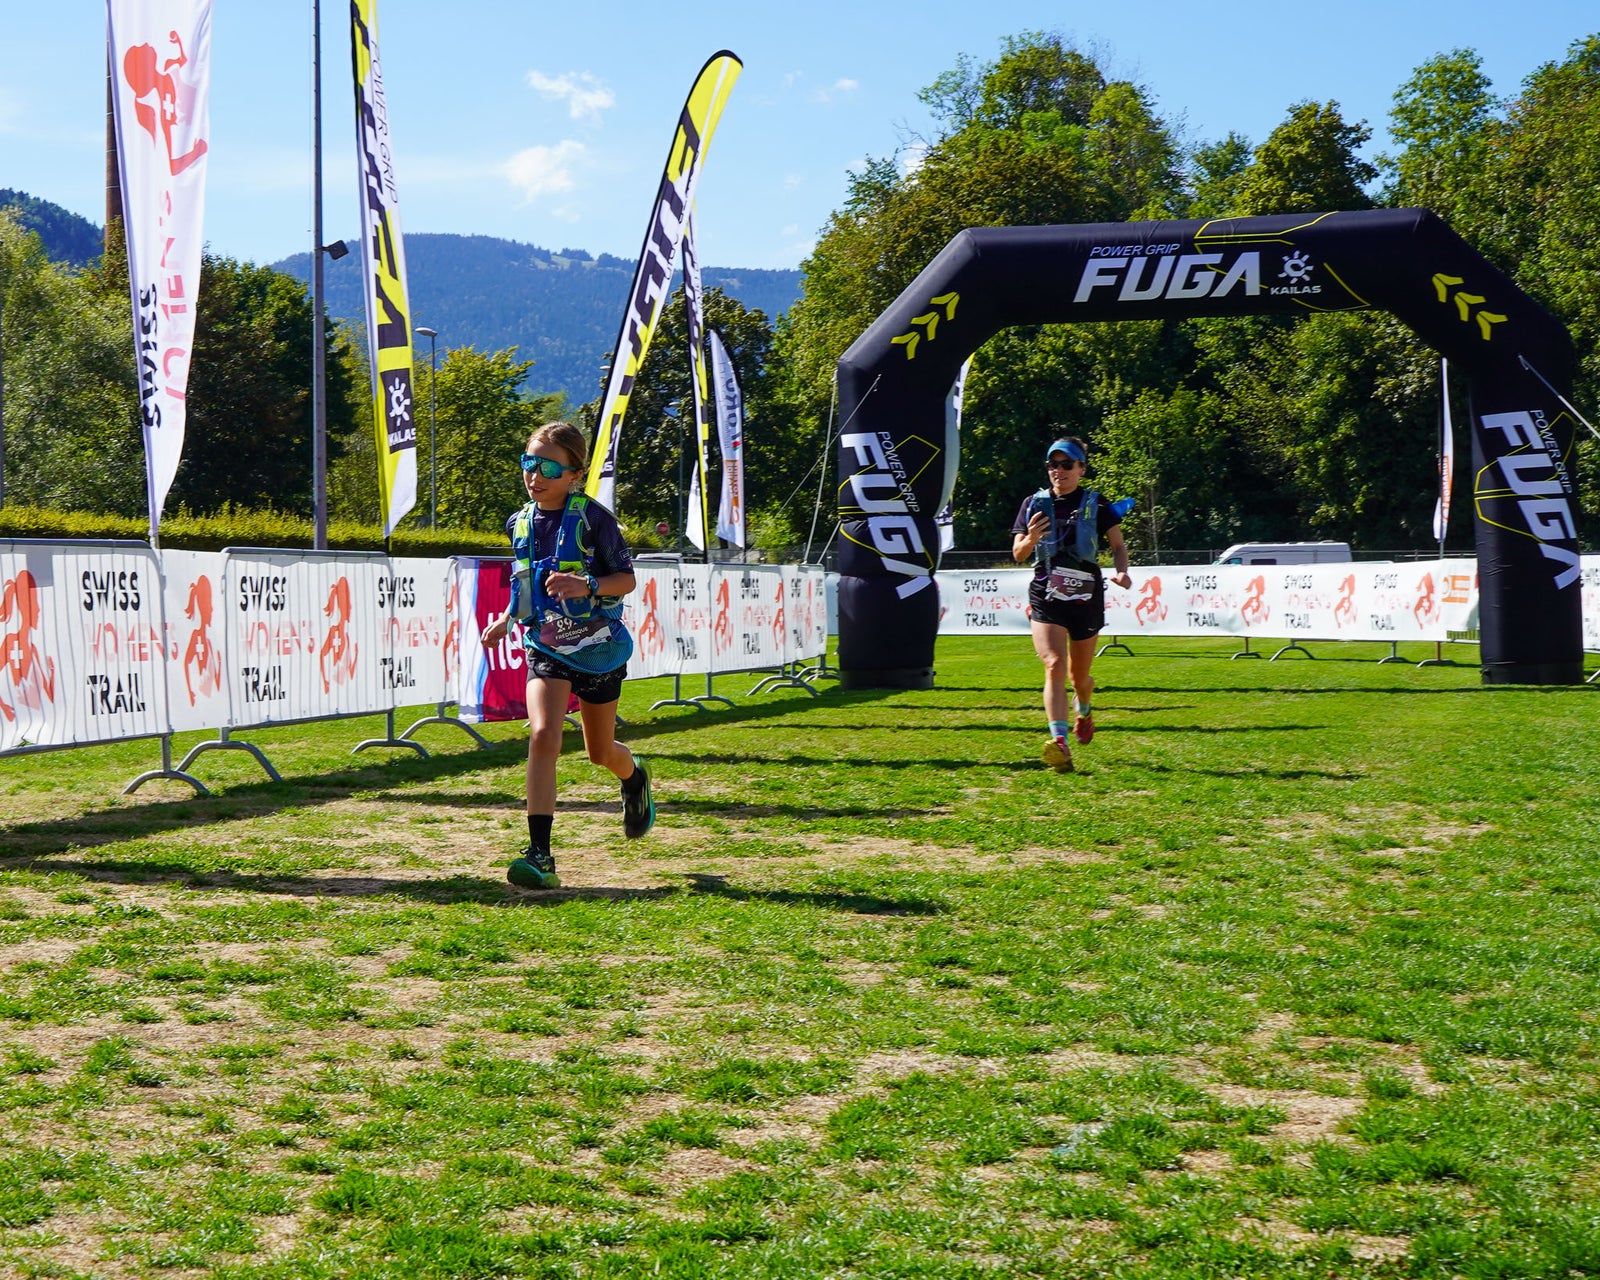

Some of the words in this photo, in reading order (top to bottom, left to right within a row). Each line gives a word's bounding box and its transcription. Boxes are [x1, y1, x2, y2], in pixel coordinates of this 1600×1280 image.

[380, 142, 398, 204] GRIP
[1090, 245, 1141, 257] POWER
[1145, 243, 1181, 255] GRIP
[1072, 251, 1261, 303] FUGA
[1270, 285, 1322, 295] KAILAS
[139, 283, 162, 429] SWISS
[1529, 409, 1561, 459] POWER
[1554, 460, 1573, 494] GRIP
[877, 431, 907, 481] POWER
[899, 481, 921, 513] GRIP
[840, 432, 933, 600] FUGA
[1480, 410, 1581, 591] FUGA
[82, 570, 141, 611] SWISS
[240, 576, 287, 612] SWISS
[378, 576, 416, 608] SWISS
[673, 577, 696, 601] SWISS
[964, 578, 999, 593] SWISS
[1184, 575, 1218, 590] SWISS
[1284, 574, 1313, 590] SWISS
[1374, 574, 1398, 589] SWISS
[965, 612, 999, 627] TRAIL
[1187, 612, 1220, 627] TRAIL
[1284, 613, 1312, 629] TRAIL
[1371, 614, 1396, 631] TRAIL
[242, 665, 286, 703] TRAIL
[380, 656, 416, 690] TRAIL
[87, 673, 146, 715] TRAIL
